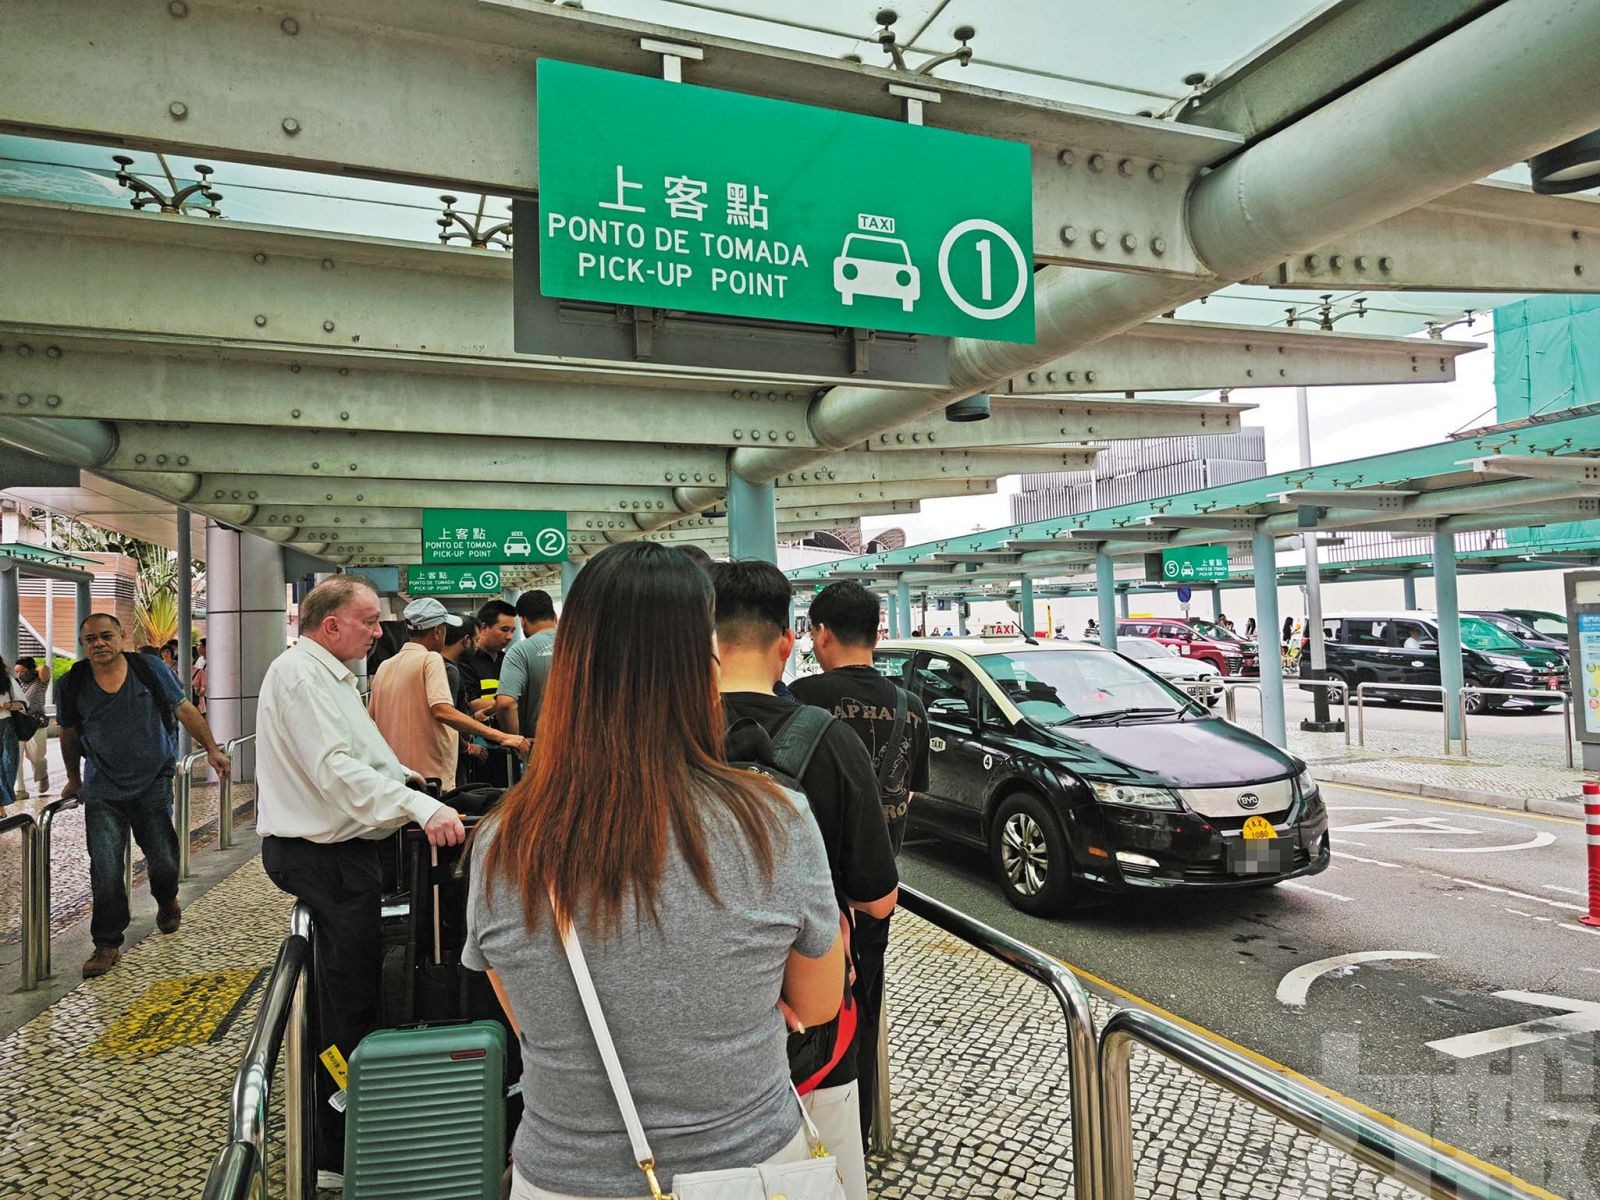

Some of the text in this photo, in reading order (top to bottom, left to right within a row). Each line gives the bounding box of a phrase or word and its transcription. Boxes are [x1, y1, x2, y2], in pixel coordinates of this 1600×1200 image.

[598, 164, 769, 230] 上客點
[860, 215, 893, 231] TAXI
[548, 212, 808, 268] PONTO DE TOMADA
[578, 252, 788, 298] PICK-UP POINT
[976, 239, 991, 300] 1
[438, 527, 486, 540] 上客點
[425, 541, 497, 549] PONTO DE TOMADA
[544, 532, 557, 551] 2
[433, 550, 464, 558] PICK-UP
[485, 574, 494, 586] 3
[989, 625, 1014, 635] TAXI
[931, 739, 943, 749] TAXI
[984, 756, 990, 768] 4
[1241, 797, 1257, 805] BYD
[1246, 819, 1268, 831] TAXI
[1251, 830, 1269, 839] 1080
